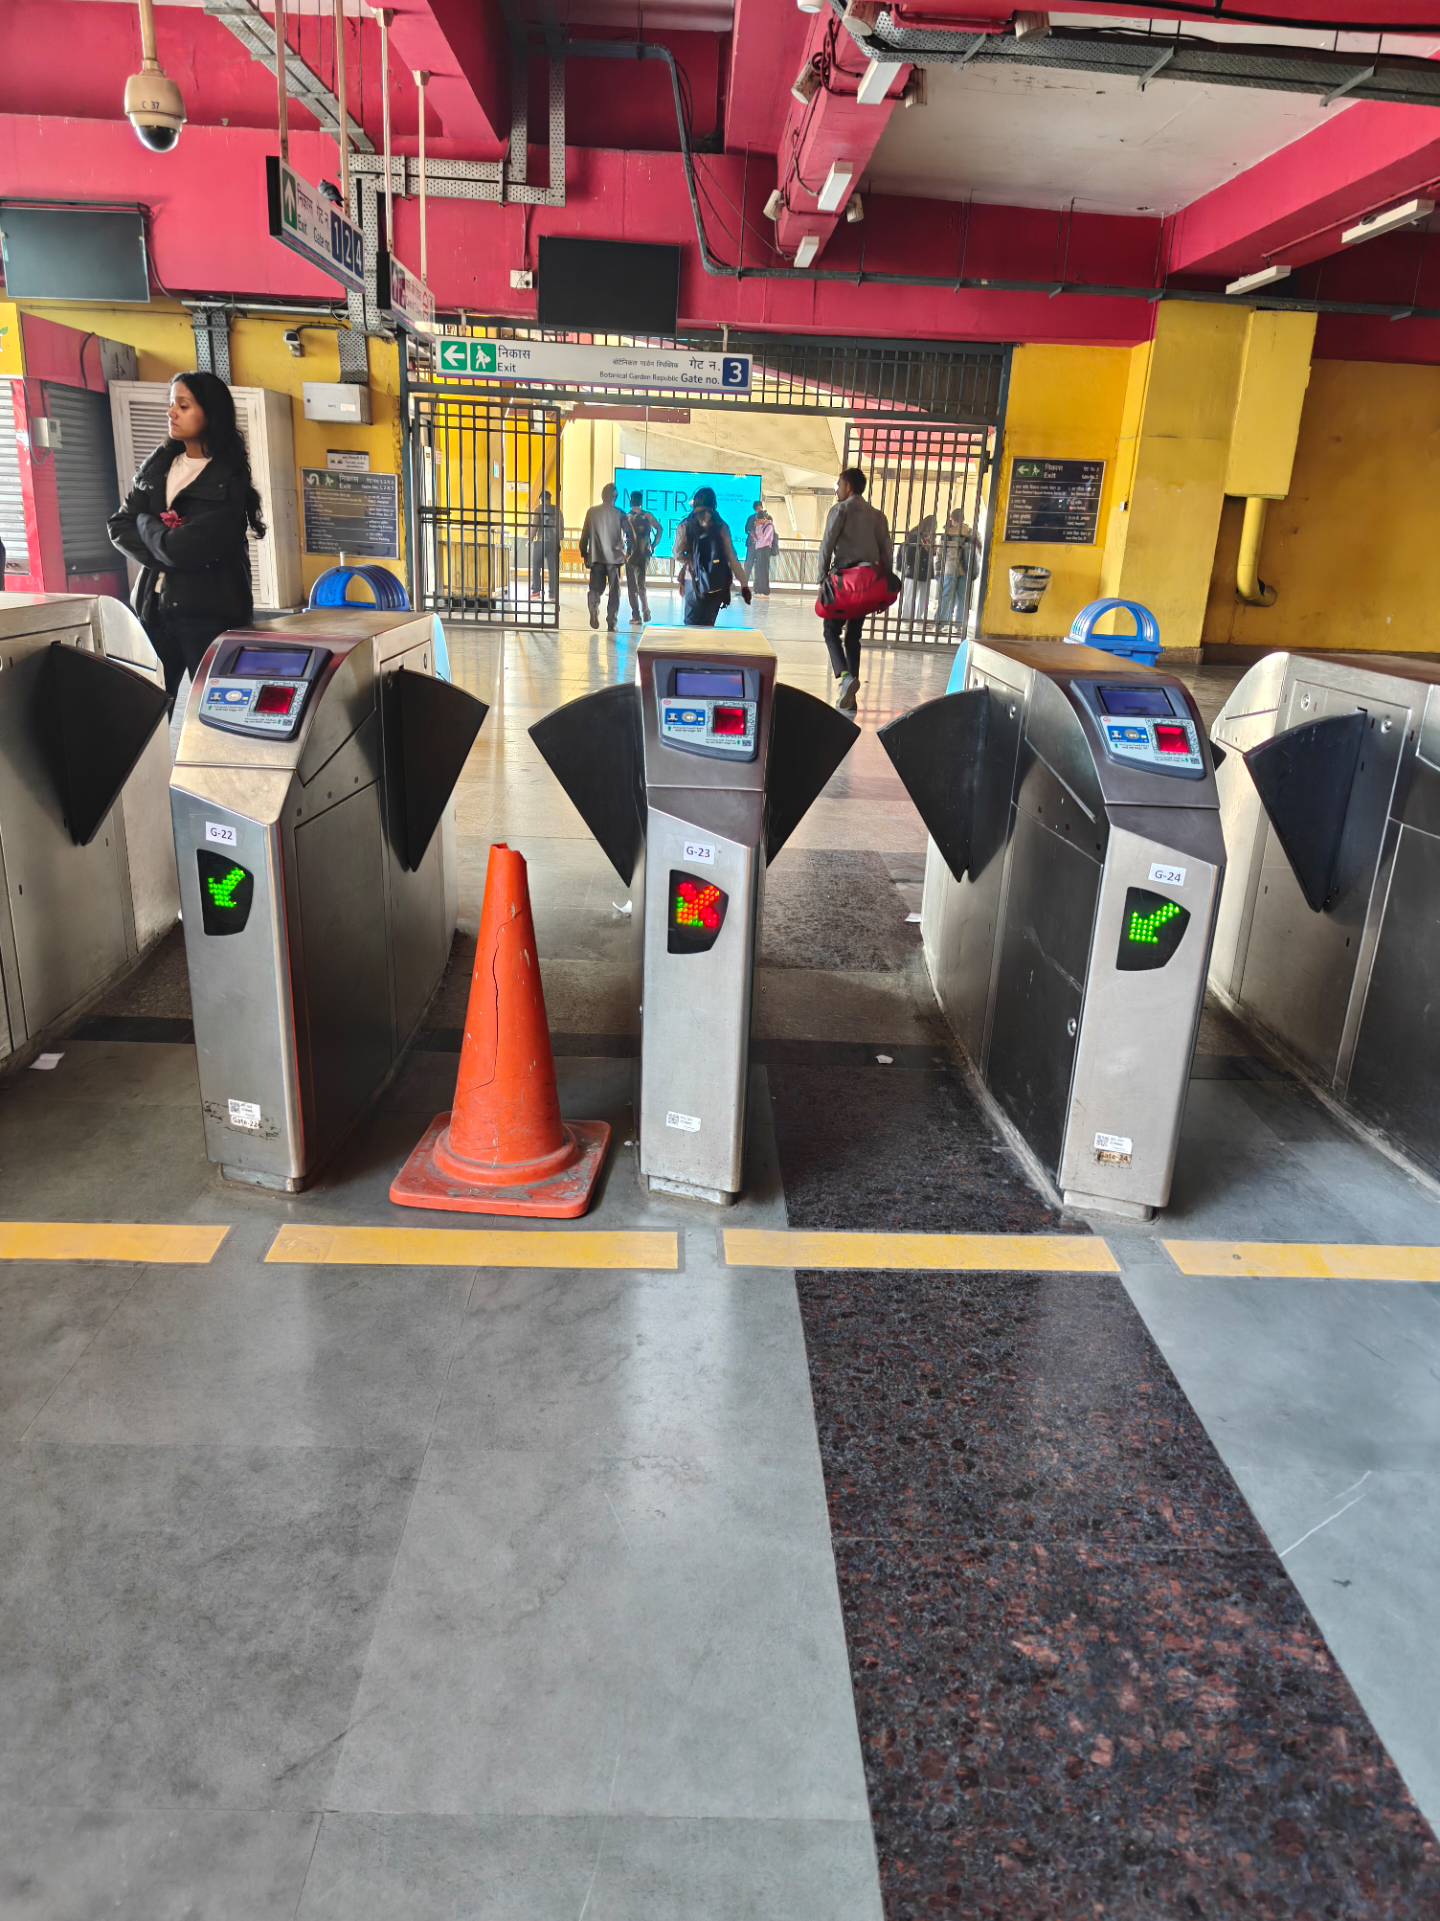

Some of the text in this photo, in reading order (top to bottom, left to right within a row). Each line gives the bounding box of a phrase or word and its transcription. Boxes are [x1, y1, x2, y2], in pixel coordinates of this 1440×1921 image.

[150, 100, 160, 110] 37
[297, 213, 308, 236] Exit
[313, 226, 325, 248] Gate
[344, 230, 352, 265] 2
[355, 239, 362, 273] 4
[498, 344, 531, 360] निकास
[497, 362, 517, 373] Exit
[689, 356, 705, 370] गेट
[708, 360, 721, 371] न.
[599, 361, 742, 385] Botanical Garden Republic Gate no. 3
[1043, 471, 1057, 479] Exit
[339, 482, 352, 490] Exit
[210, 827, 234, 841] G-22
[685, 845, 711, 858] G-23
[1154, 869, 1182, 883] G-24
[231, 1116, 258, 1128] Gate-22
